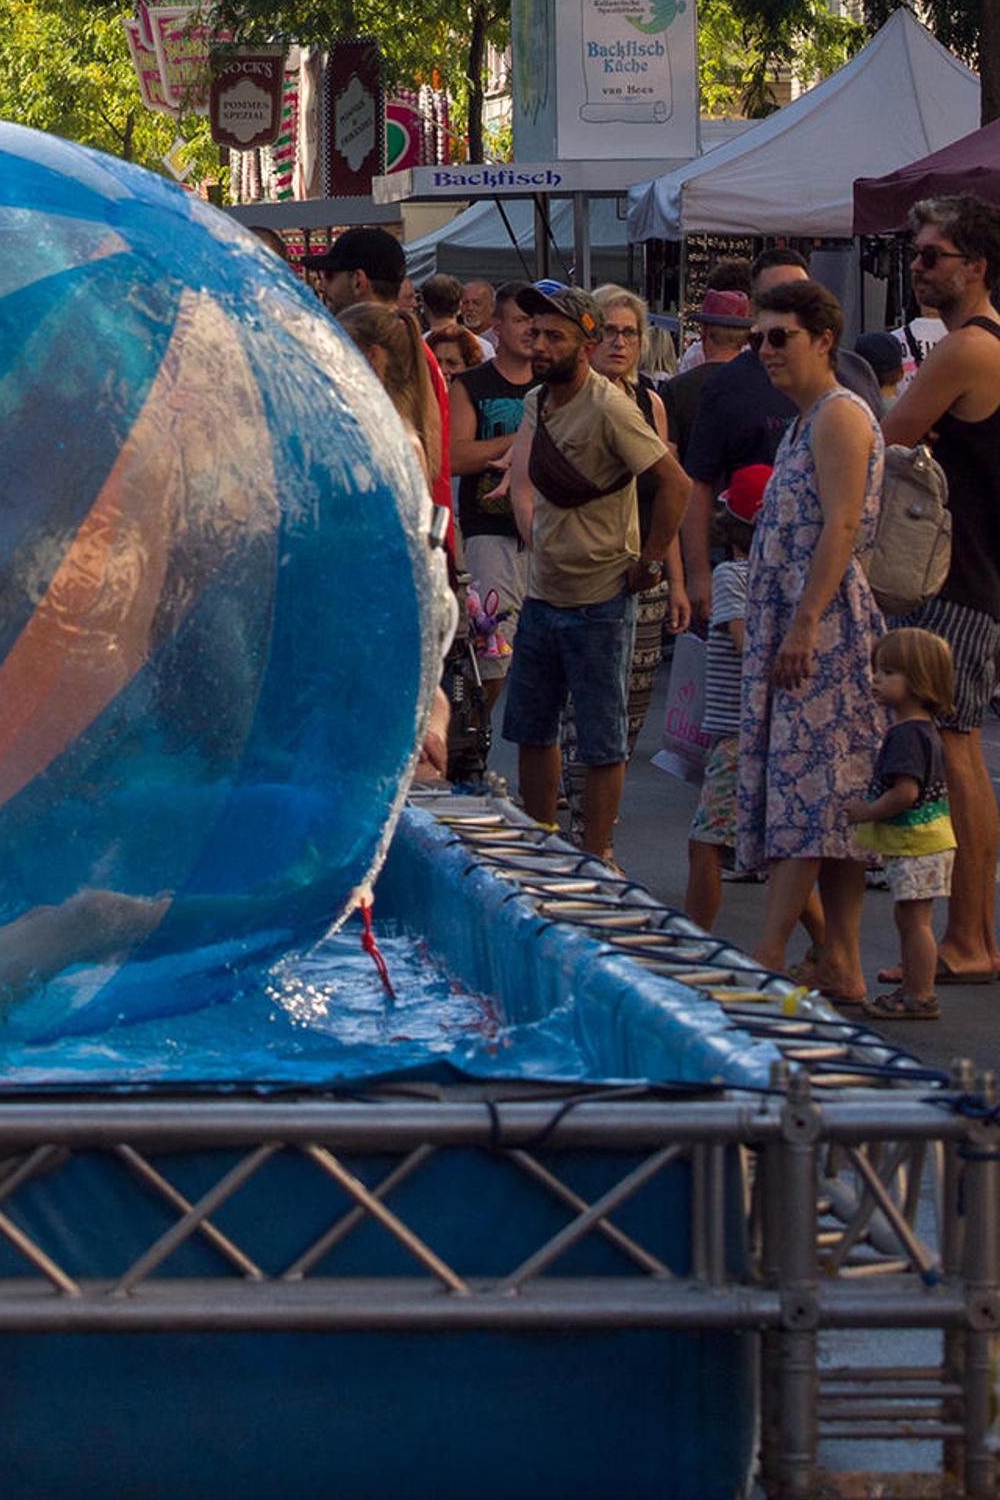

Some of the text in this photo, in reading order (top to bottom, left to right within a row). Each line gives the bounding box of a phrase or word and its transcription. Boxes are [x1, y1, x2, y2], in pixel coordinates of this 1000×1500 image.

[587, 40, 665, 59] Backfisch
[604, 58, 649, 73] Küche
[223, 100, 270, 109] POMMES
[223, 111, 264, 120] SPEZIAL
[433, 170, 562, 188] Backfisch
